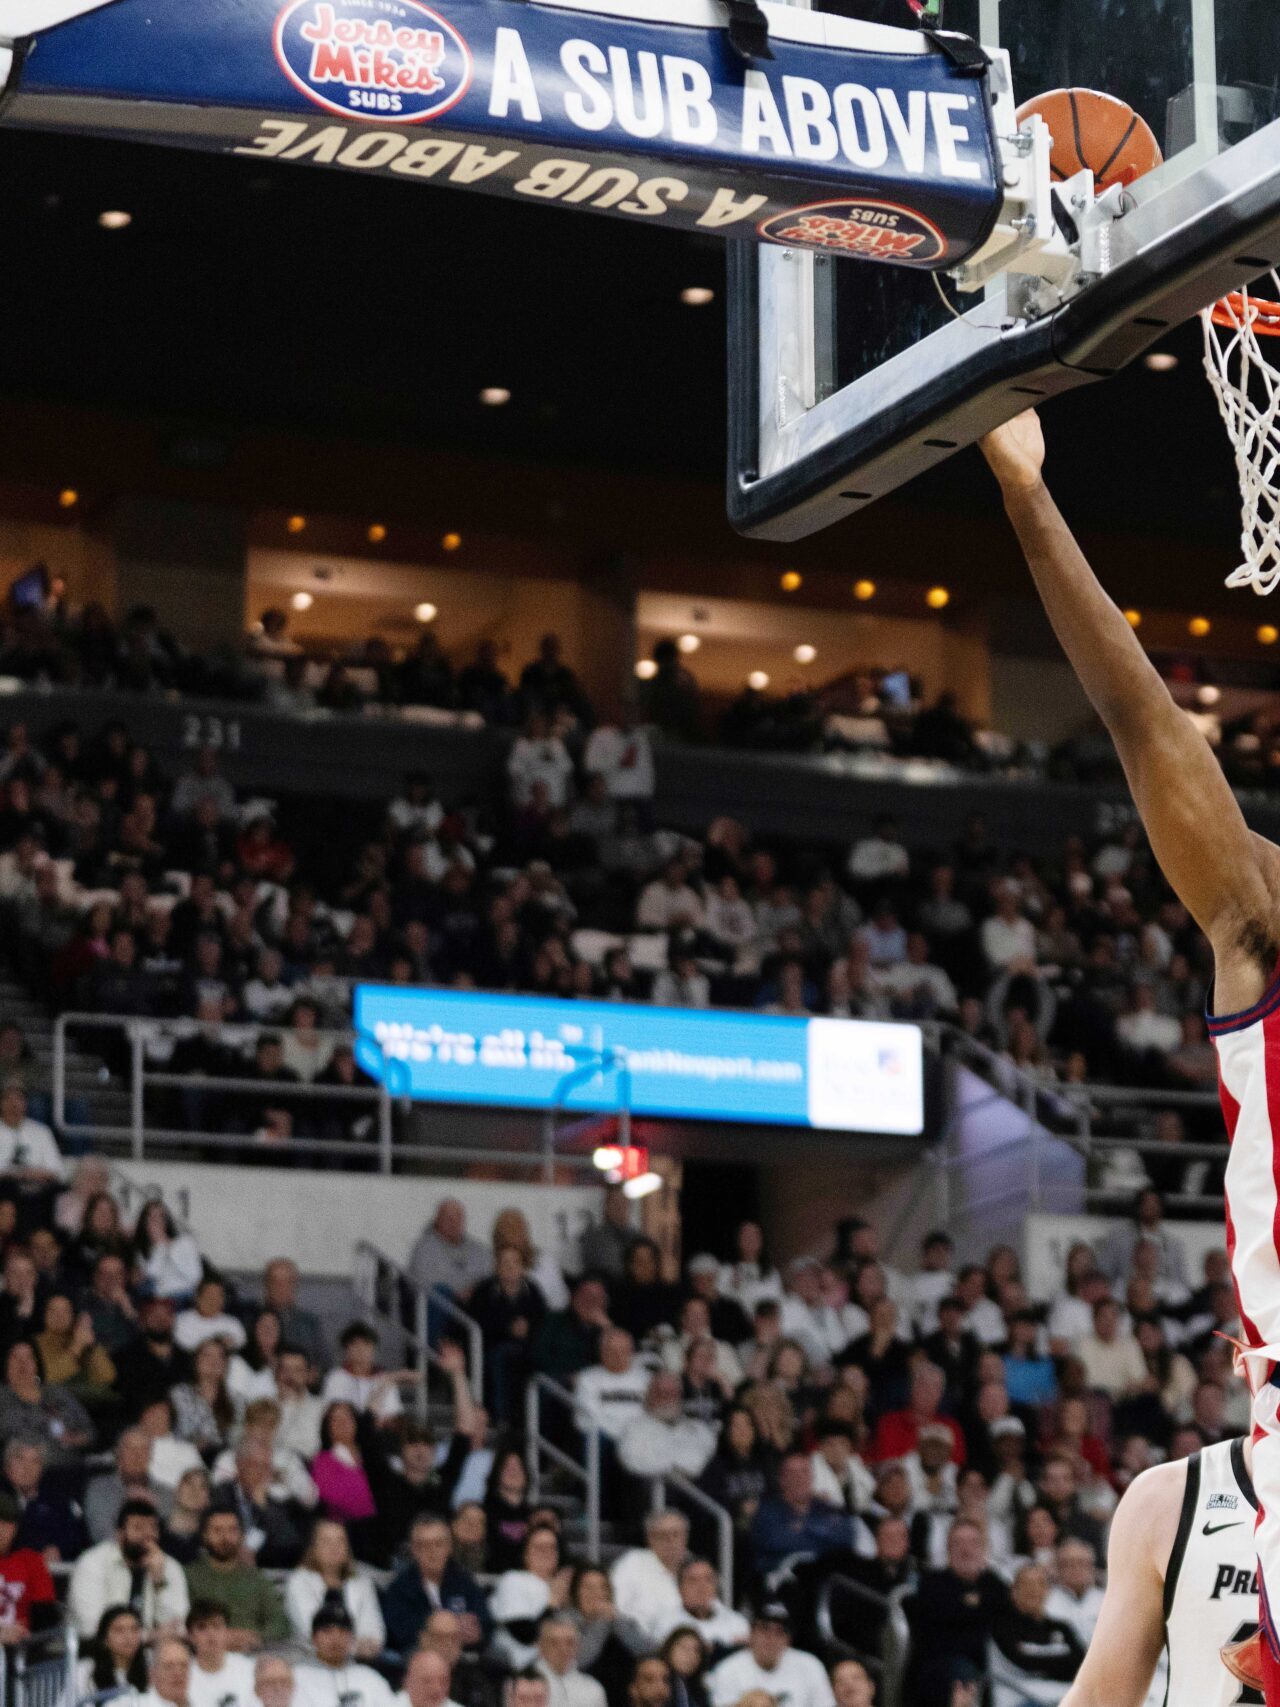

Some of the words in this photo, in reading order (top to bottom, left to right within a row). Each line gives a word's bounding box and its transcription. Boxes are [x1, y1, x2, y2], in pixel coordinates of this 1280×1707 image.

[300, 3, 446, 64] Jersey
[309, 42, 445, 94] Mike's
[348, 89, 403, 112] SUBS
[487, 26, 543, 123] A
[559, 38, 718, 146] SUB
[740, 68, 982, 181] ABOVE
[233, 119, 521, 184] ABOVE
[513, 158, 689, 216] SUB
[695, 187, 769, 228] A
[849, 207, 900, 227] SUBS
